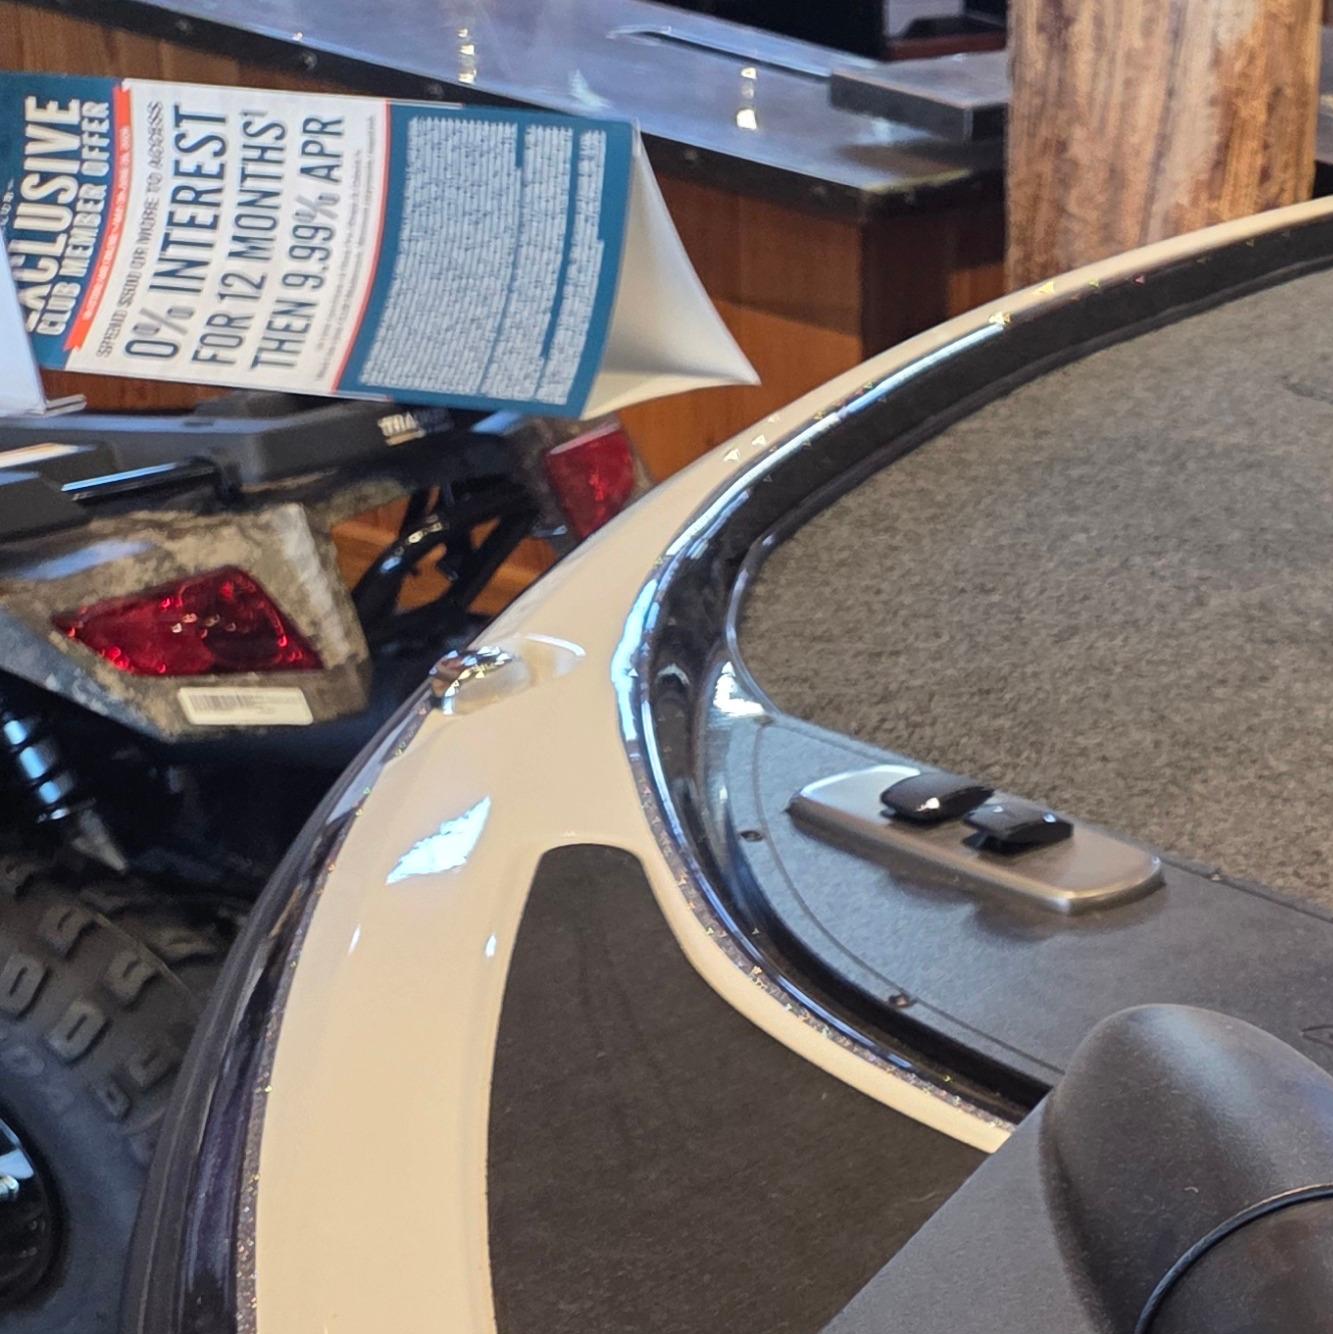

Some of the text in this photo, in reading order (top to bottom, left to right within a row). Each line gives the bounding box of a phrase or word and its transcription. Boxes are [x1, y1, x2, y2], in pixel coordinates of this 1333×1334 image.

[81, 101, 110, 177] OFFER
[147, 100, 164, 169] ACCESS
[147, 174, 163, 193] TO
[58, 183, 107, 277] MEMBER
[122, 102, 228, 360] 0% INTEREST
[138, 194, 160, 248] MORE
[250, 115, 345, 369] THEN 9.99% APR
[36, 281, 81, 336] CLUB
[218, 272, 267, 301] 12
[96, 306, 128, 359] SPEND
[191, 312, 254, 366] FOR
